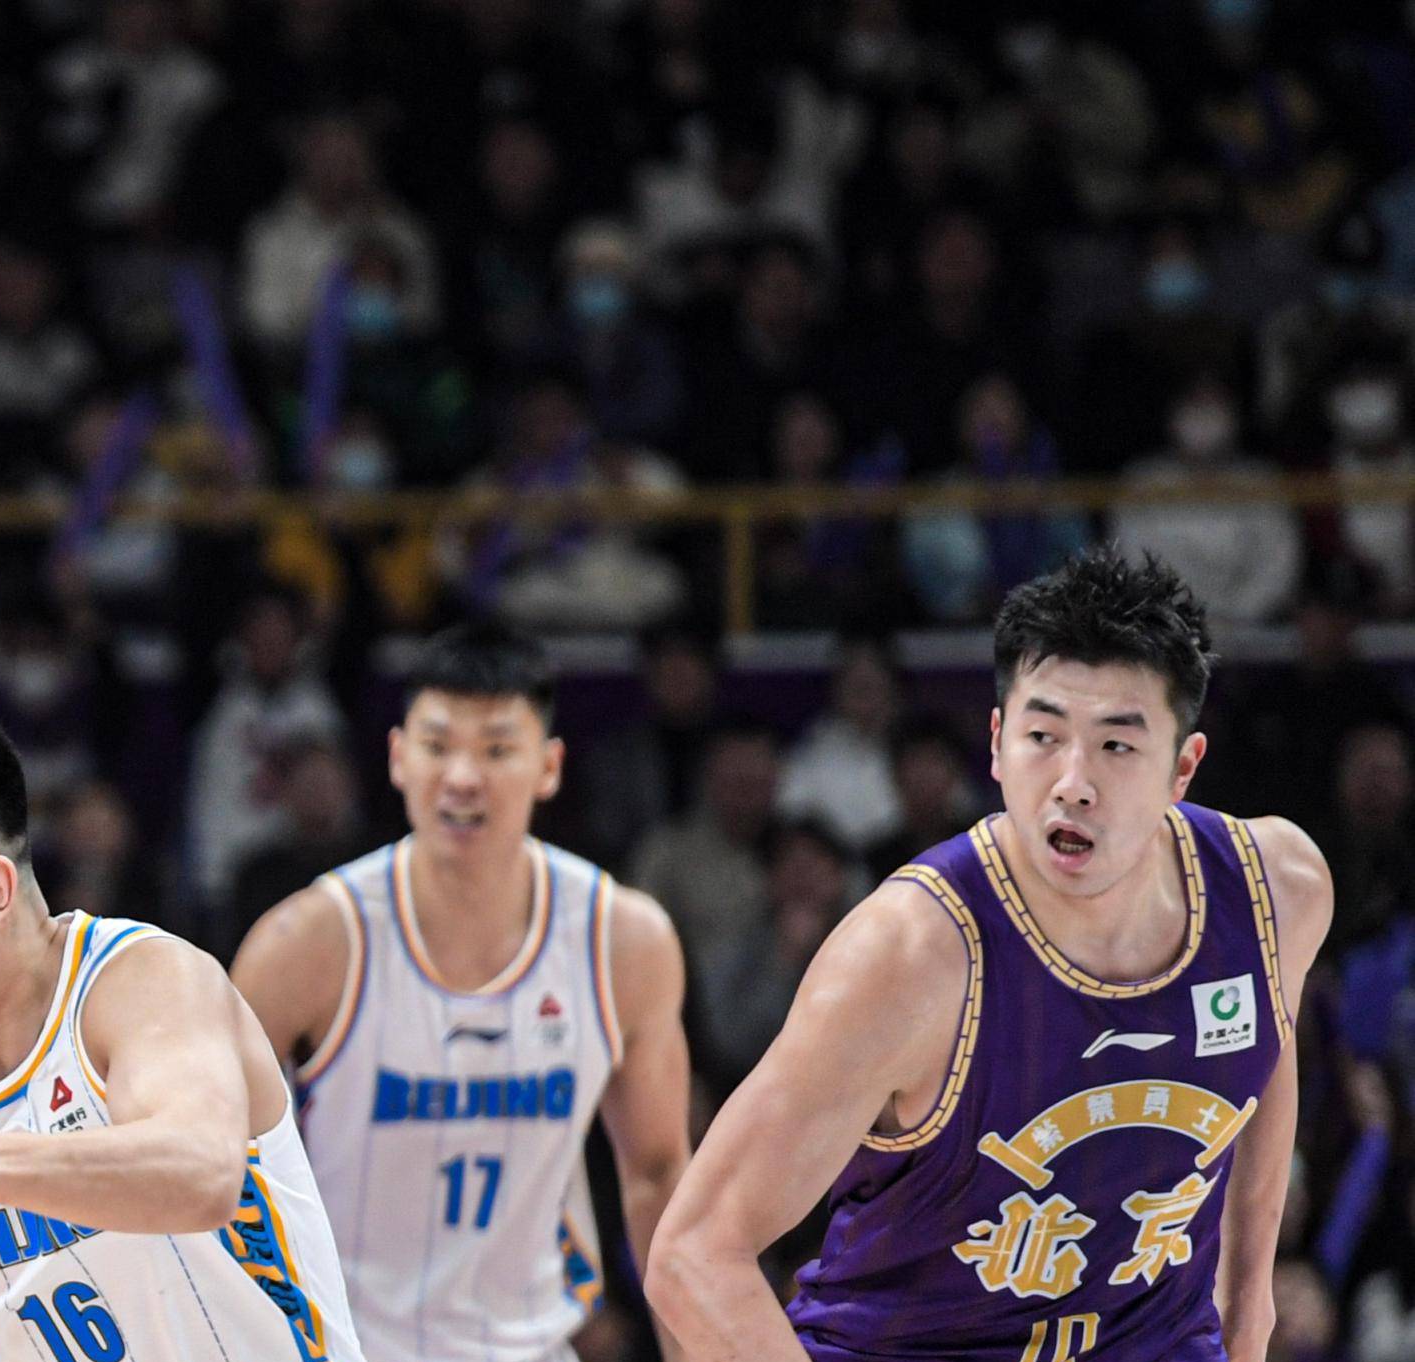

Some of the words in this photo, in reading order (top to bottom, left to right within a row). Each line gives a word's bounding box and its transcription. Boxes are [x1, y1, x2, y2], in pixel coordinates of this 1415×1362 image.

[371, 1066, 577, 1123] BEIJING
[439, 1155, 504, 1230] 17
[953, 1172, 1223, 1300] 北京
